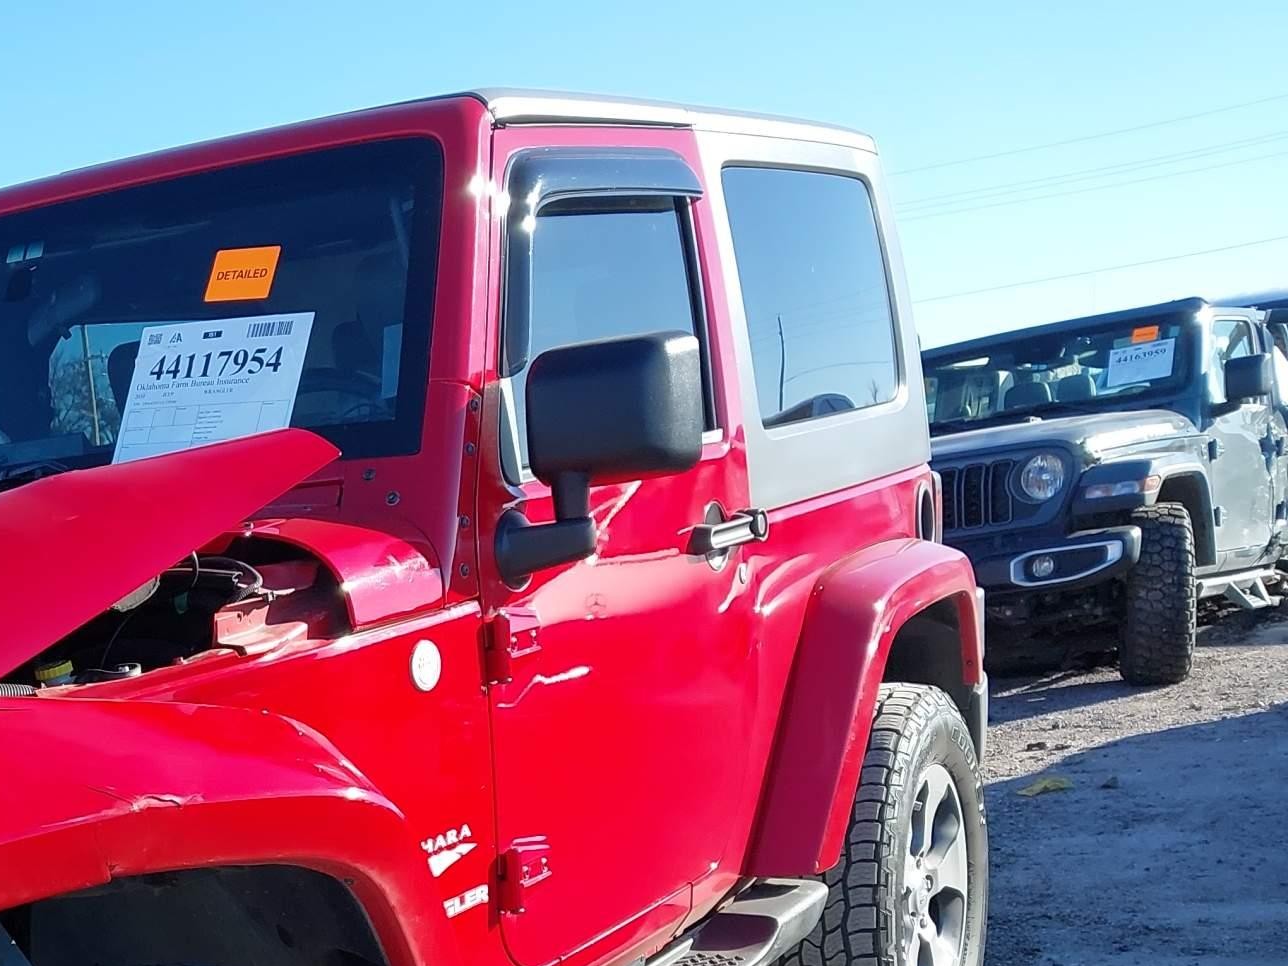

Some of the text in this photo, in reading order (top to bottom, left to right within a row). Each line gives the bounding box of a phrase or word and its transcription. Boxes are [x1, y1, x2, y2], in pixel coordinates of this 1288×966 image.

[216, 267, 268, 281] DETAILED
[150, 346, 283, 381] 44117954
[136, 376, 250, 392] Oklahoma Farm Bureau Insurance
